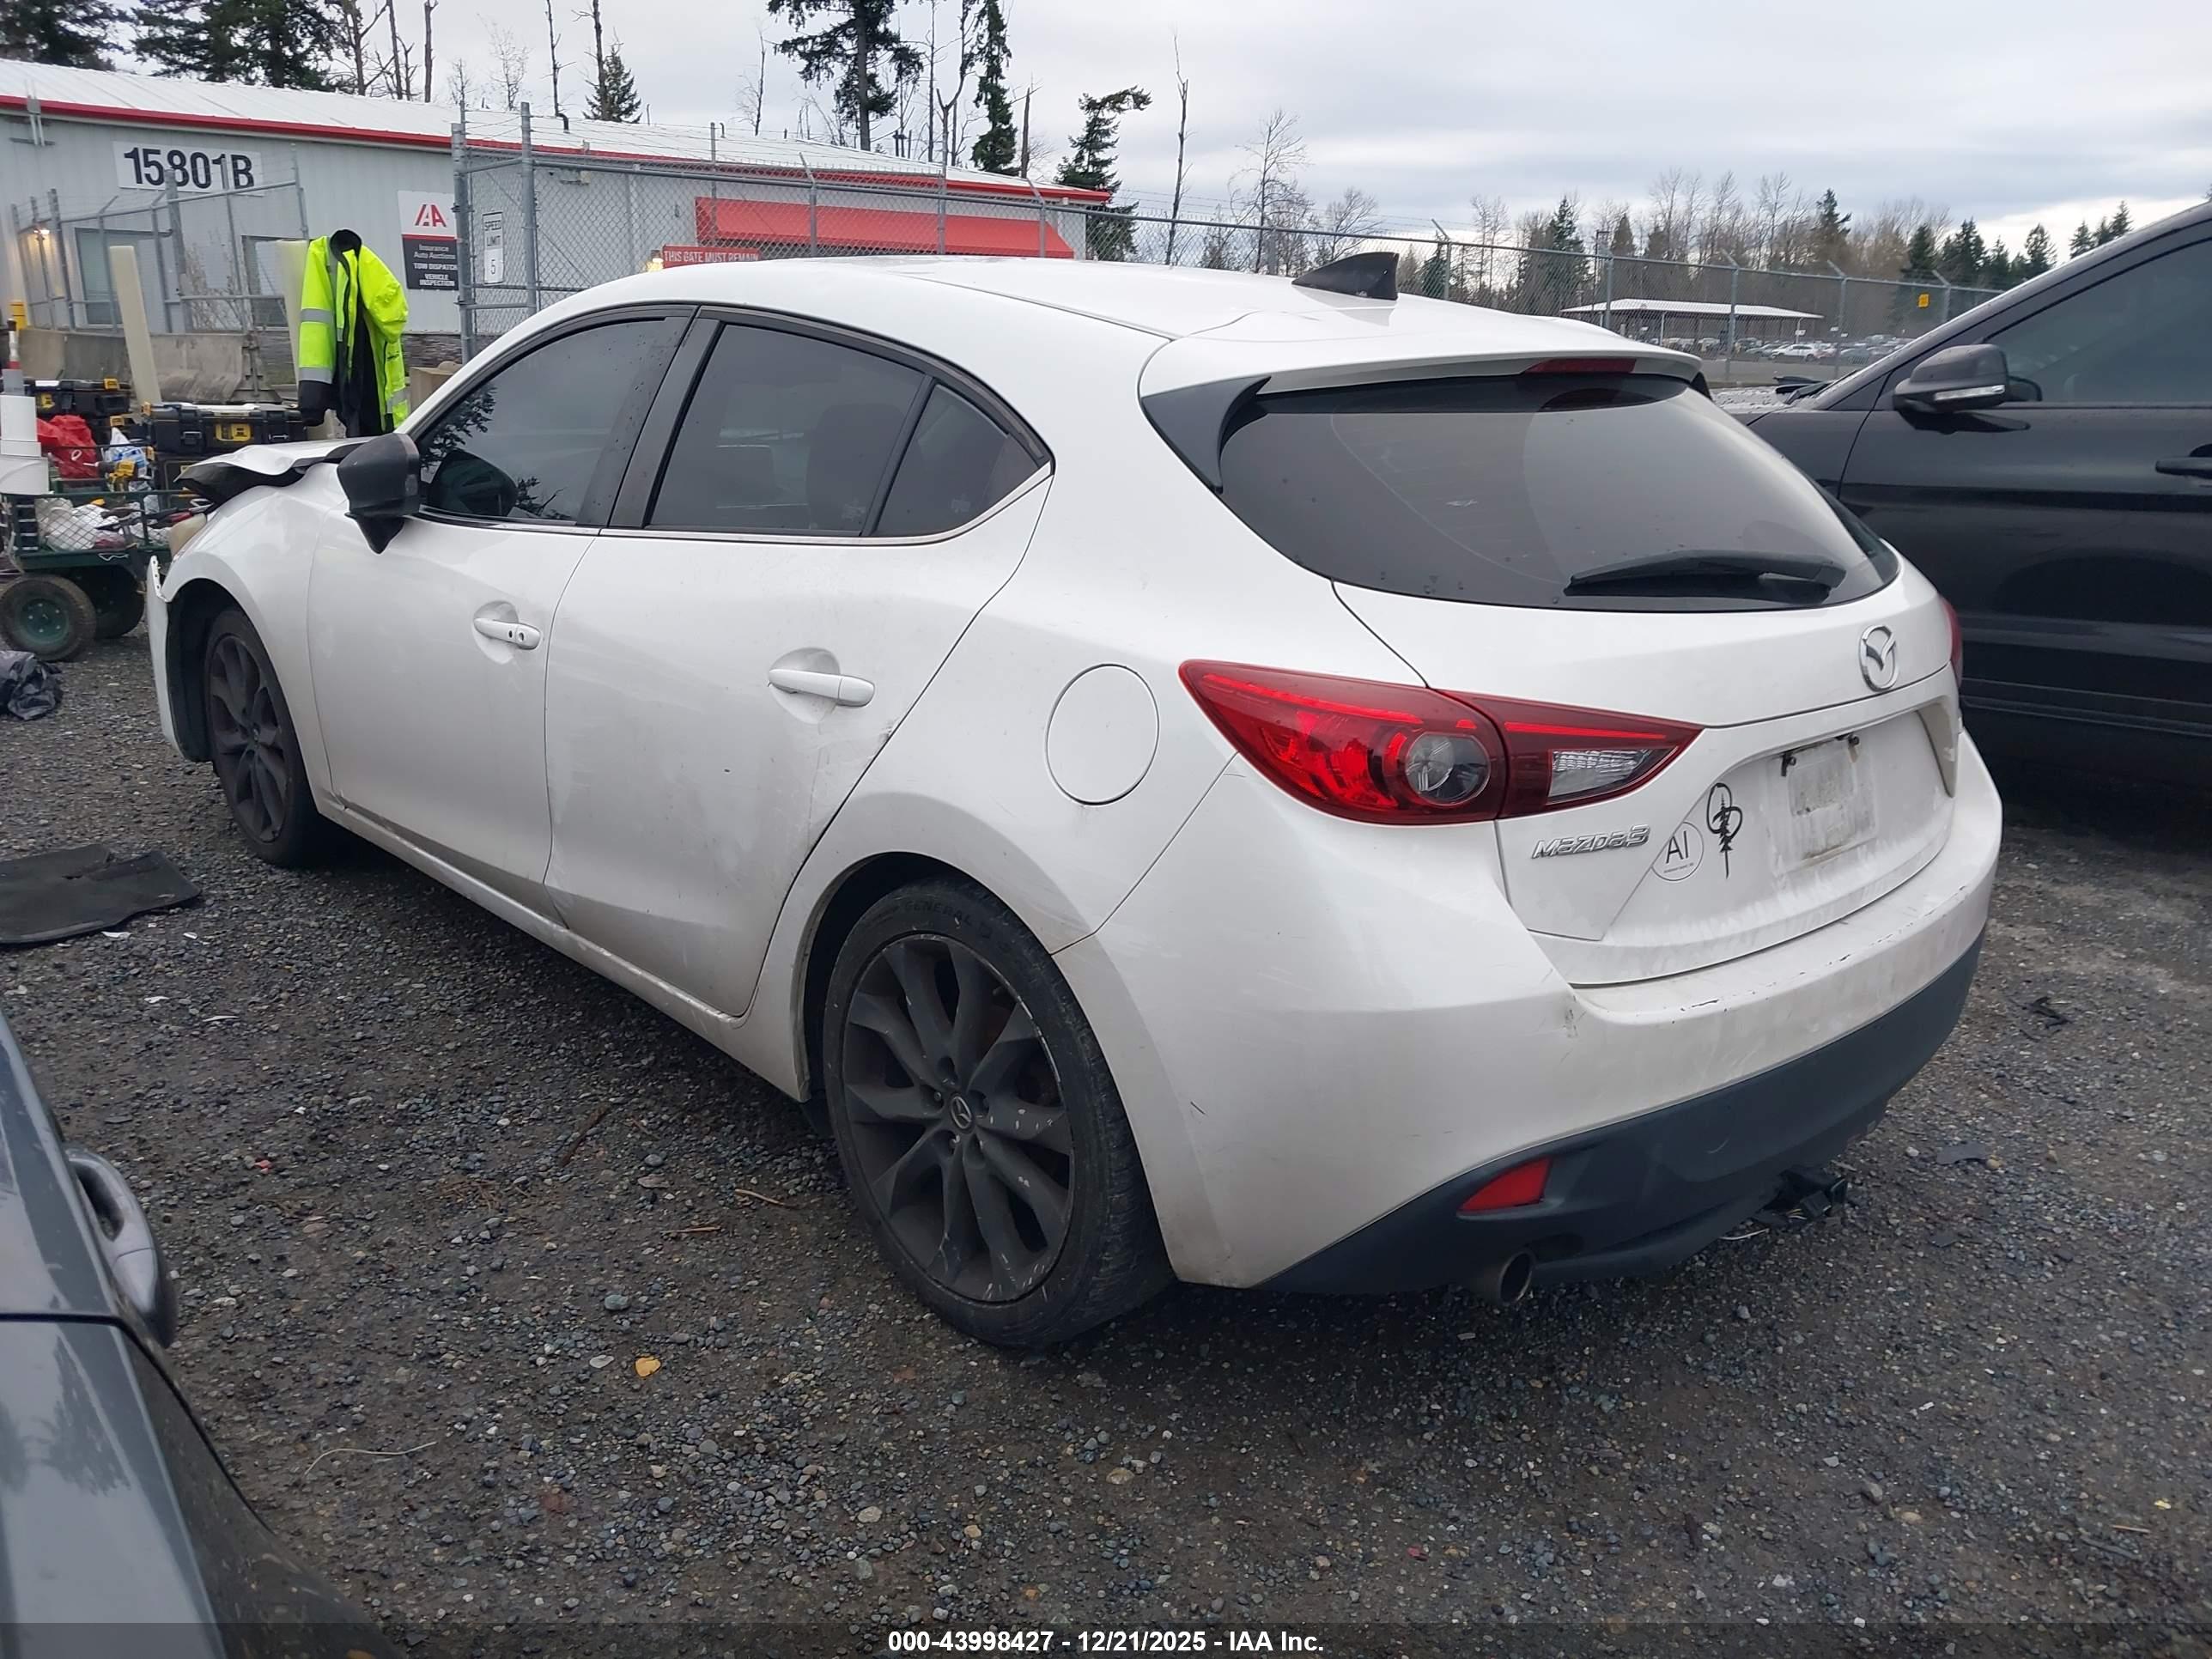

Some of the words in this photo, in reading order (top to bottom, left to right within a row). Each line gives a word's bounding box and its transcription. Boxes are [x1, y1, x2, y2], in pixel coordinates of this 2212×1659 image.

[123, 147, 255, 190] 15801B
[663, 250, 682, 262] THIS
[683, 251, 704, 263] GATE
[704, 252, 727, 263] MUST
[490, 259, 496, 274] 5
